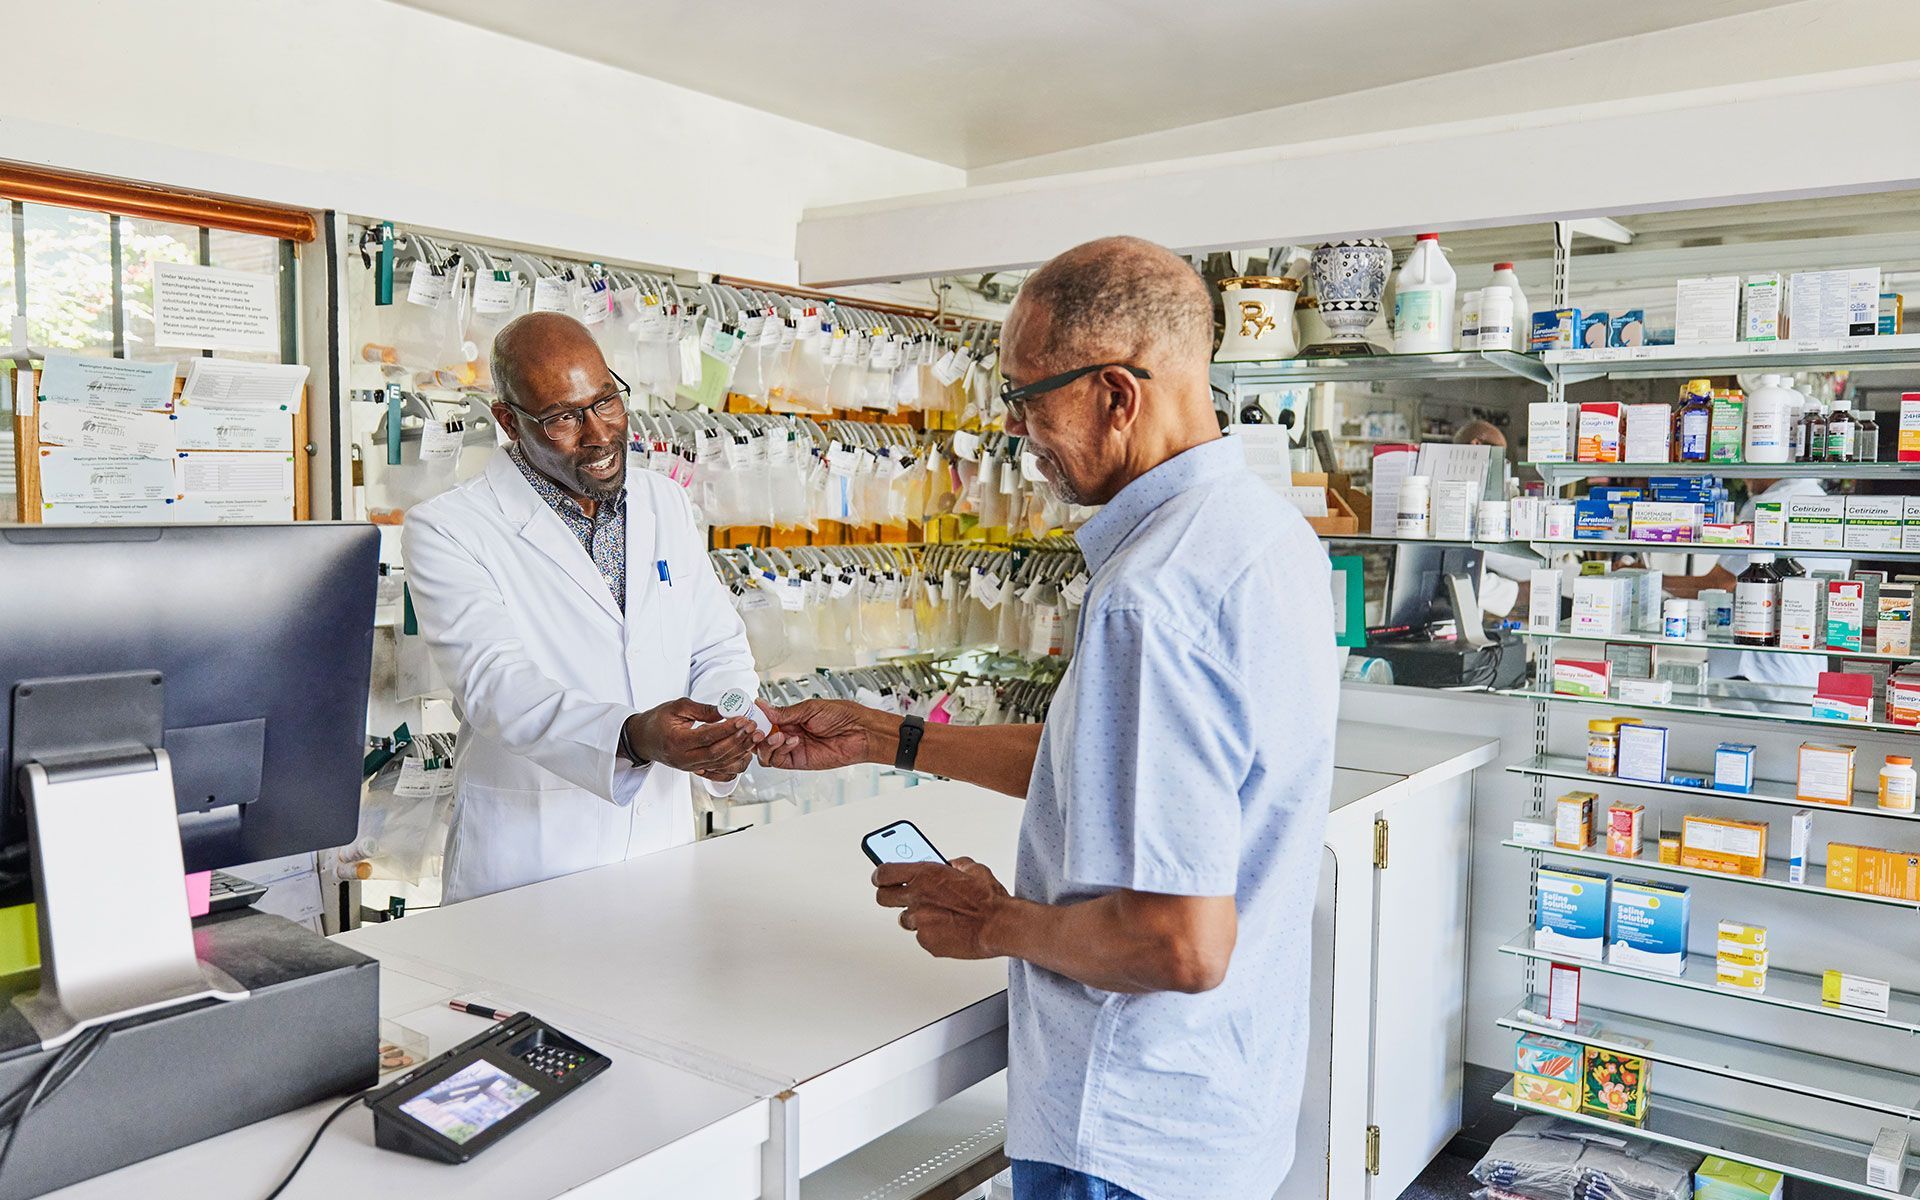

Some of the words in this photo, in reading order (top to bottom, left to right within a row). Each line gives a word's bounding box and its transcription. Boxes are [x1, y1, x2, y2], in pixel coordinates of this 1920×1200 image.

[384, 226, 393, 241] A
[1534, 326, 1558, 335] Loratadi
[390, 385, 400, 400] E
[1014, 551, 1020, 560] N
[1543, 892, 1568, 904] Saline
[396, 904, 403, 916] T
[1543, 899, 1578, 911] Solution
[1618, 905, 1644, 917] Saline
[1618, 912, 1654, 926] Solution
